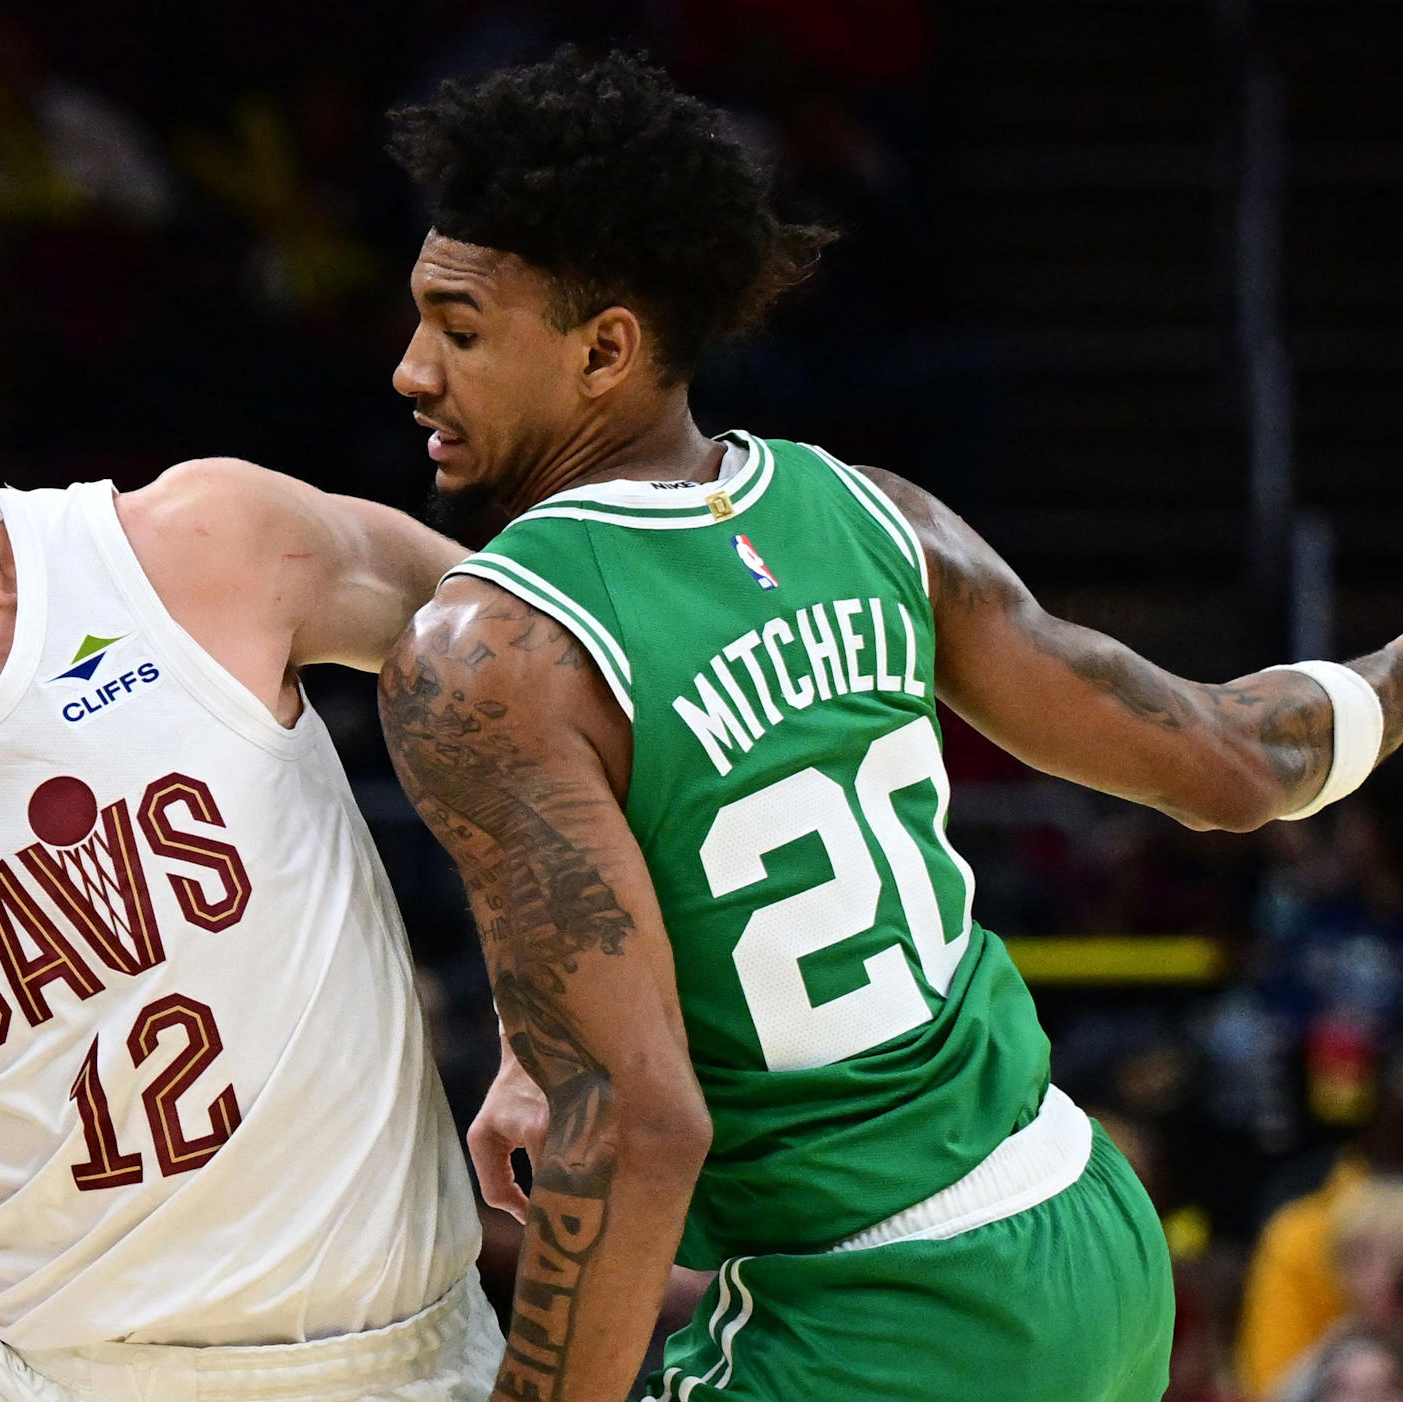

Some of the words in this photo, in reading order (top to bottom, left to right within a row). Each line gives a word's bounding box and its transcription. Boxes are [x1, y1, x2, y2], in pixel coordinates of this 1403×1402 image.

[61, 661, 161, 723] CLIFFS
[671, 597, 927, 777] MITCHELL
[698, 715, 976, 1072] 20
[69, 992, 243, 1192] 12
